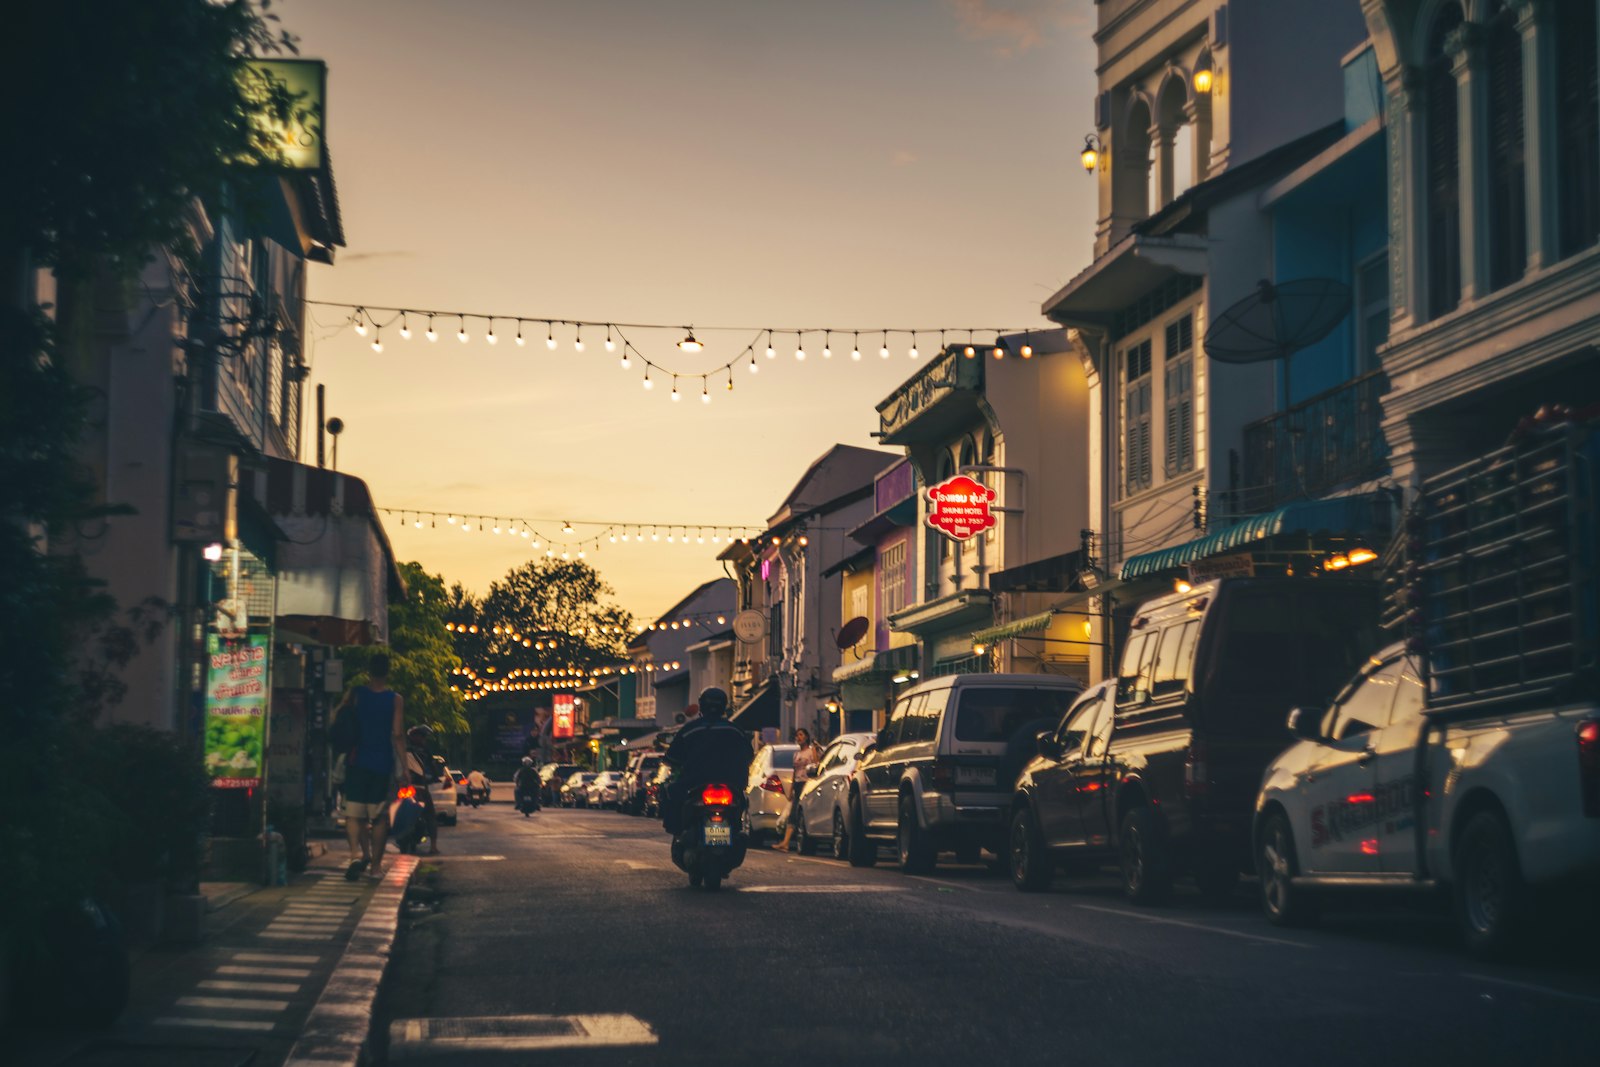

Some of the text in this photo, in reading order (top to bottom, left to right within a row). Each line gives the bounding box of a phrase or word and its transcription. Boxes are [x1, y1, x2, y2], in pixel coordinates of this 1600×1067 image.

[936, 491, 968, 503] โรงแรม
[964, 507, 983, 515] HOTEL
